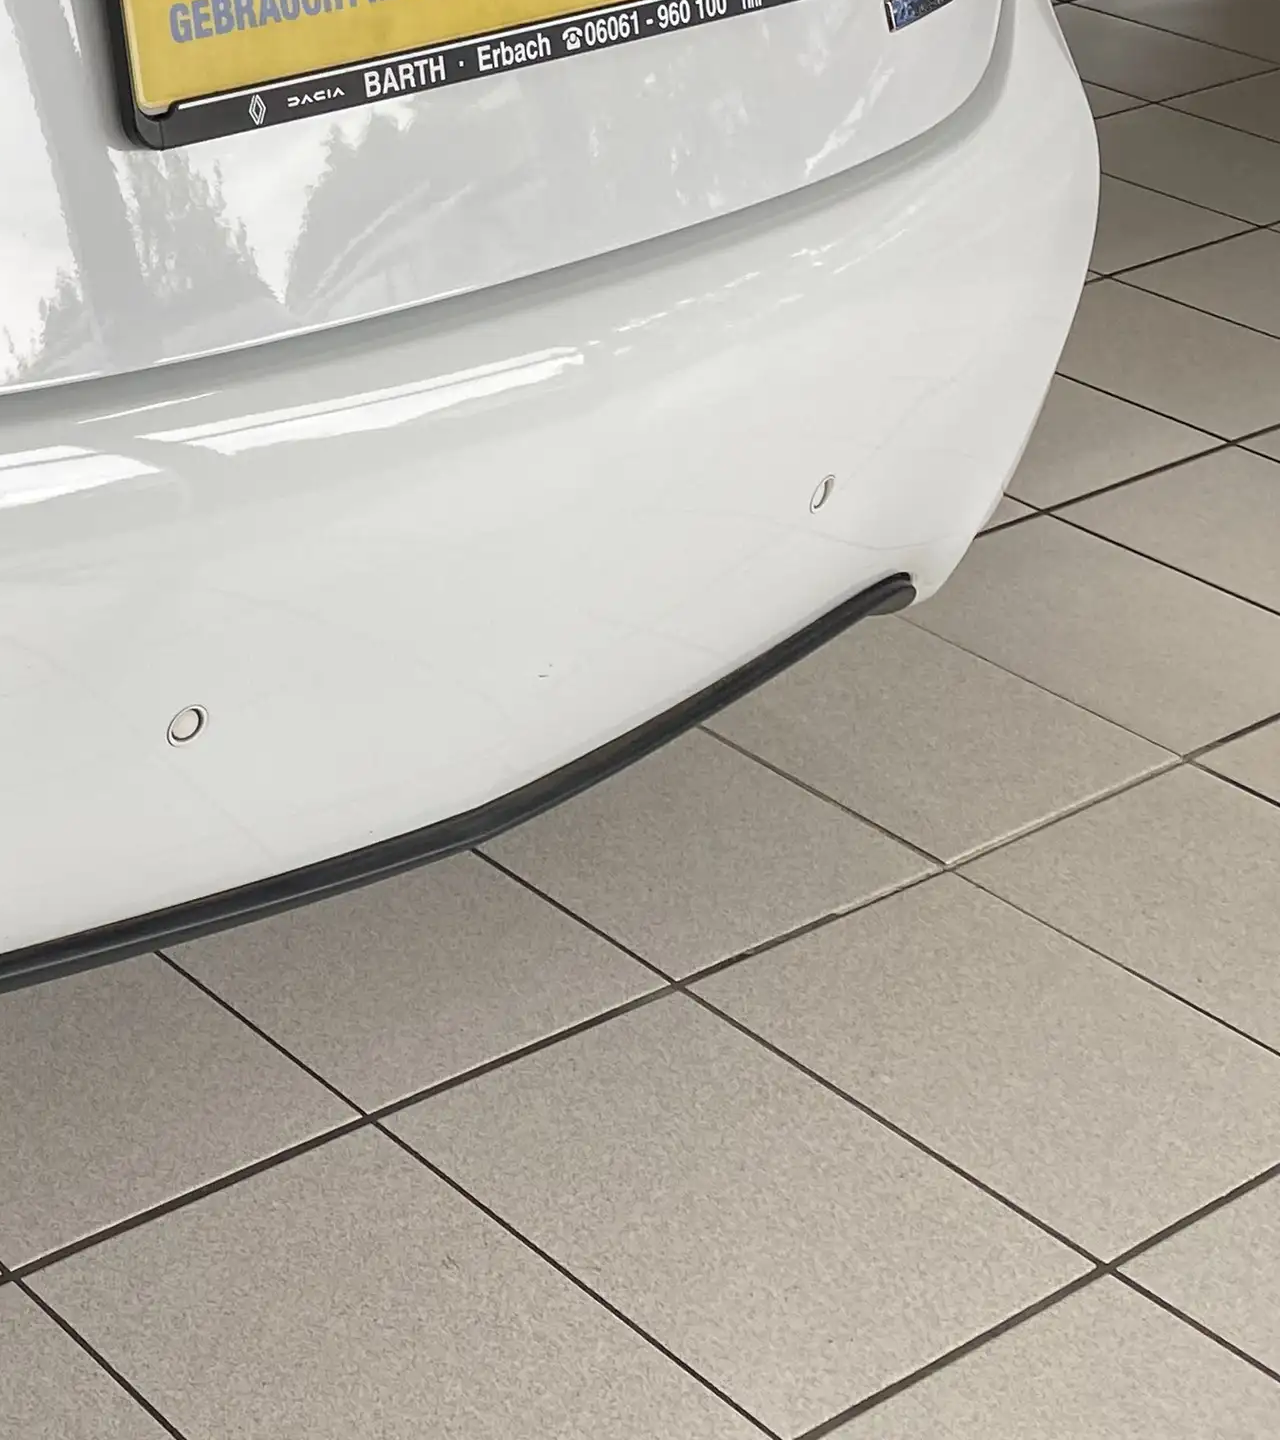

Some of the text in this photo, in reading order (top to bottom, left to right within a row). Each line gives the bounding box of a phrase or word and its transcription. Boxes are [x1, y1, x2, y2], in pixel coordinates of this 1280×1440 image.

[287, 87, 345, 108] DACIA
[363, 55, 446, 98] BARTH
[477, 32, 552, 72] Erbach
[584, 10, 640, 47] 06061
